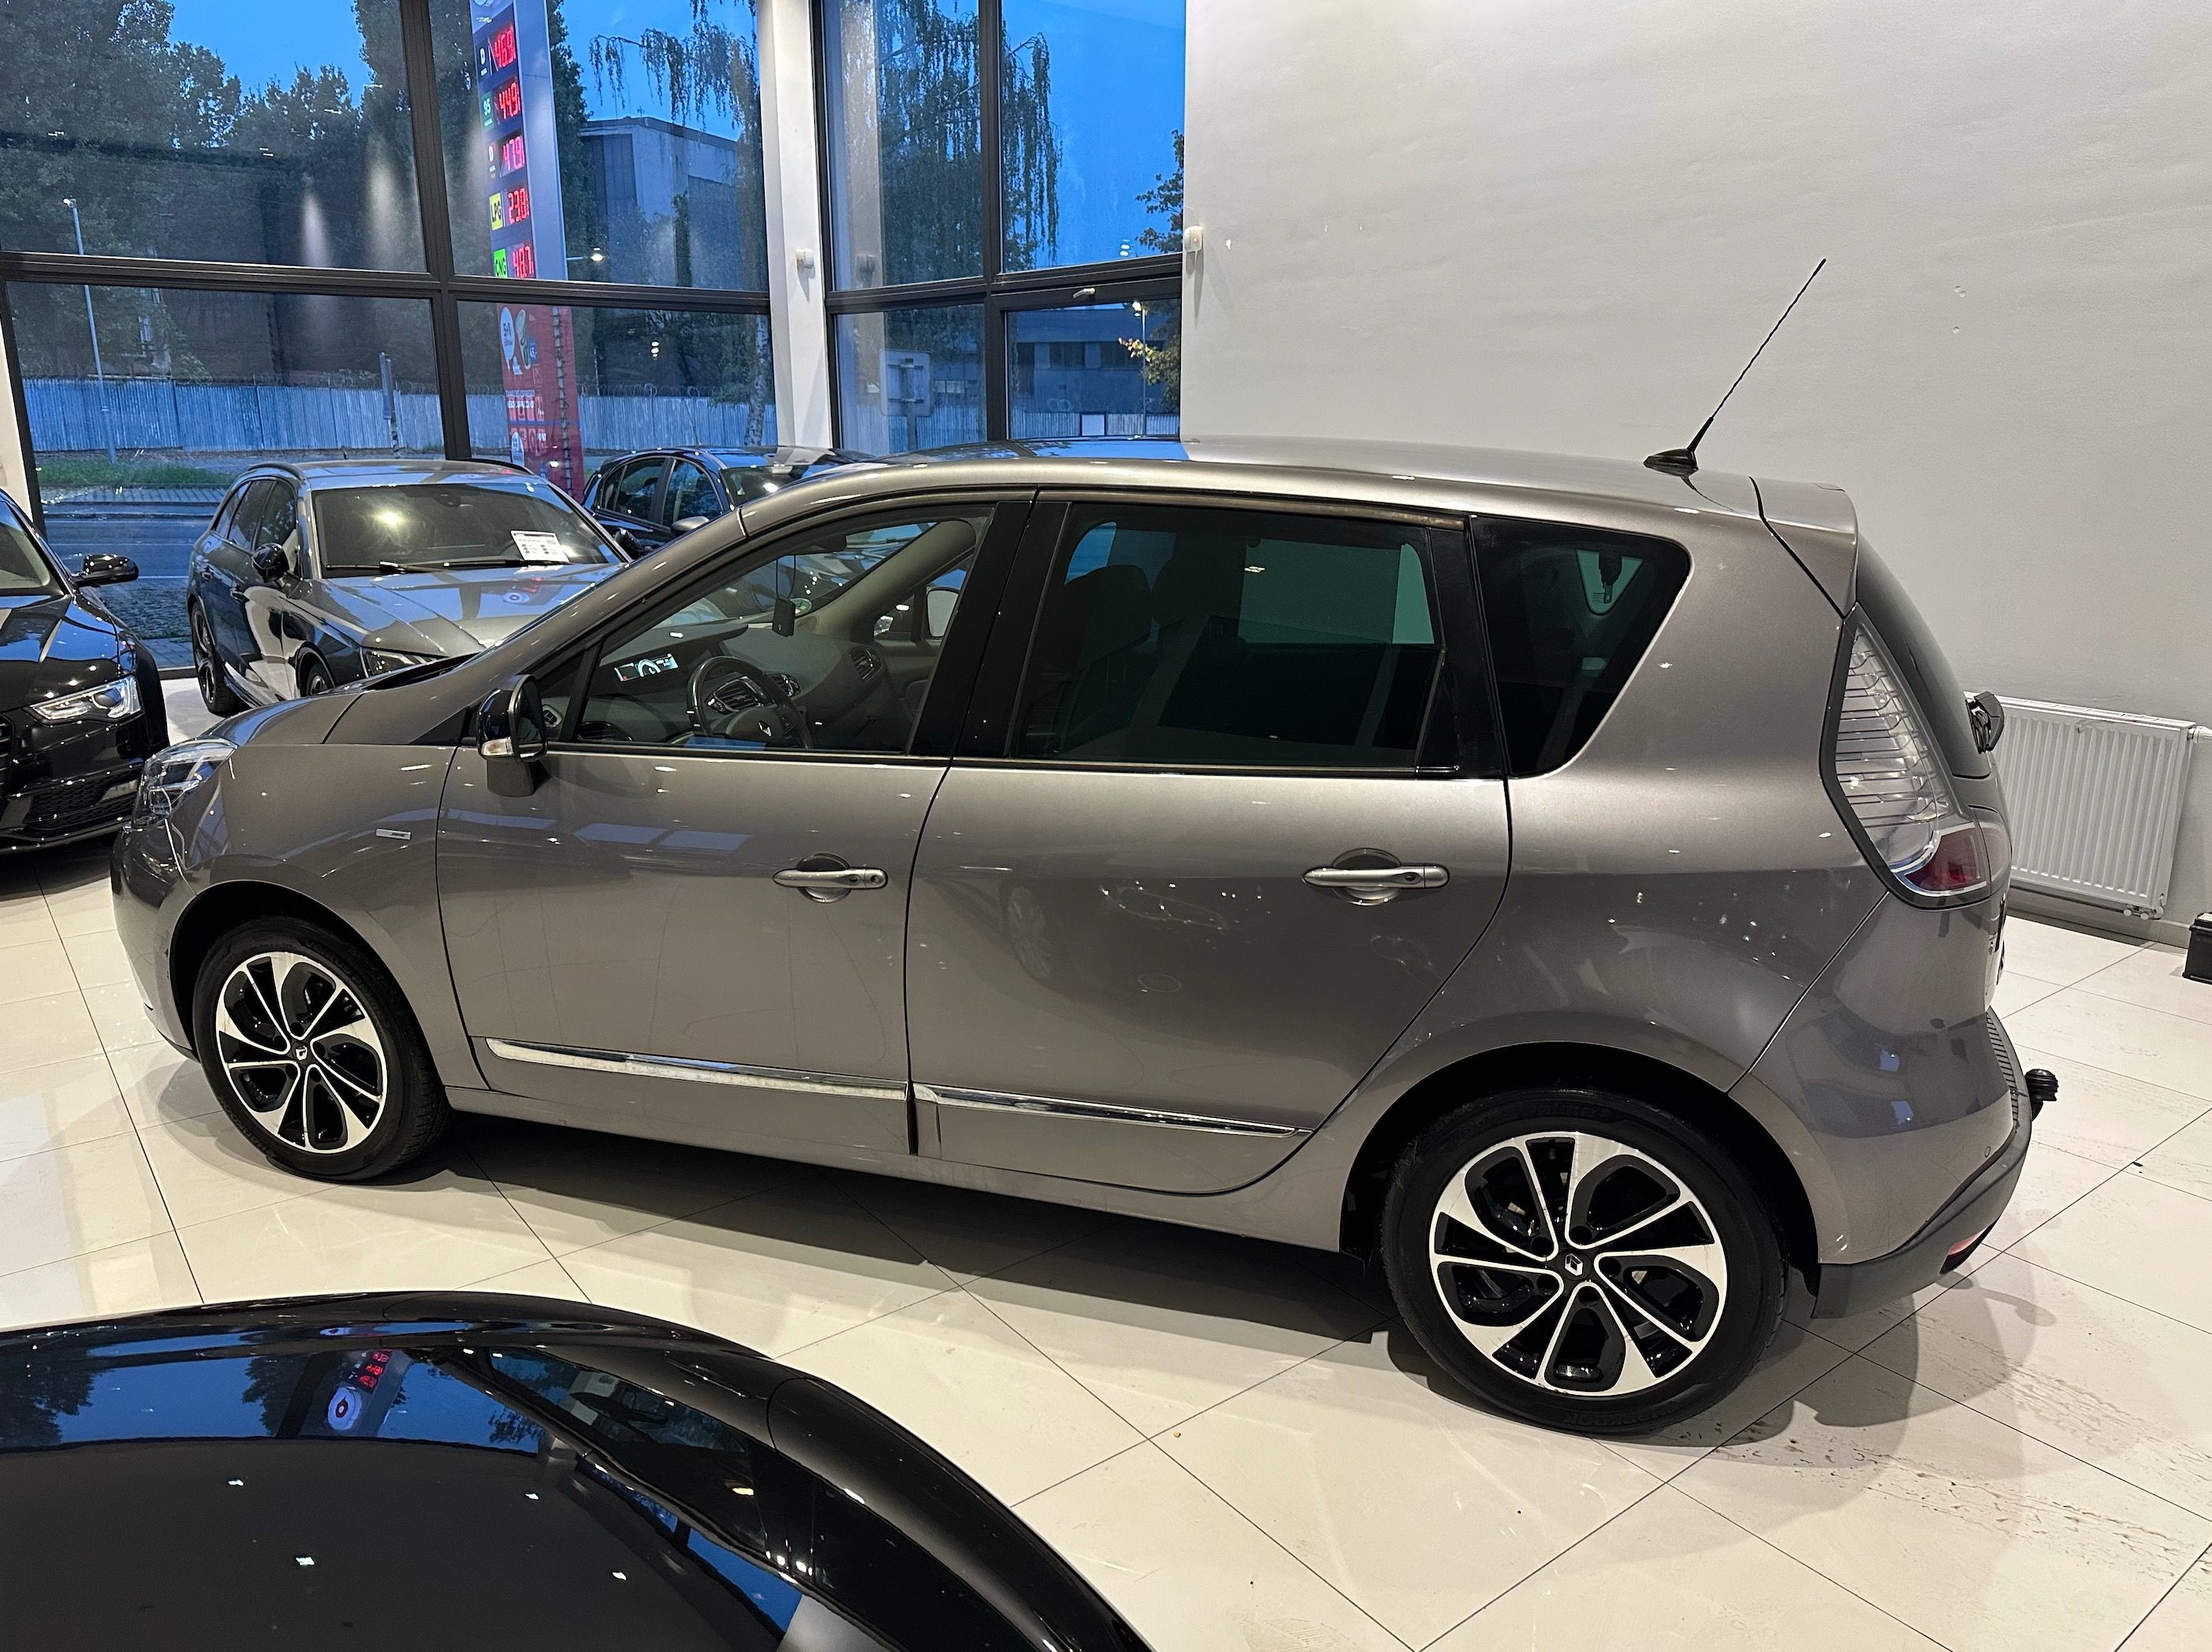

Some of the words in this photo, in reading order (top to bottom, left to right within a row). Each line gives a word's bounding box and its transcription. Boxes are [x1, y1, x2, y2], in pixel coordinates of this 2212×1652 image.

[479, 47, 486, 65] D
[483, 98, 491, 116] 95
[491, 200, 501, 223] LPG
[495, 257, 506, 277] CNG
